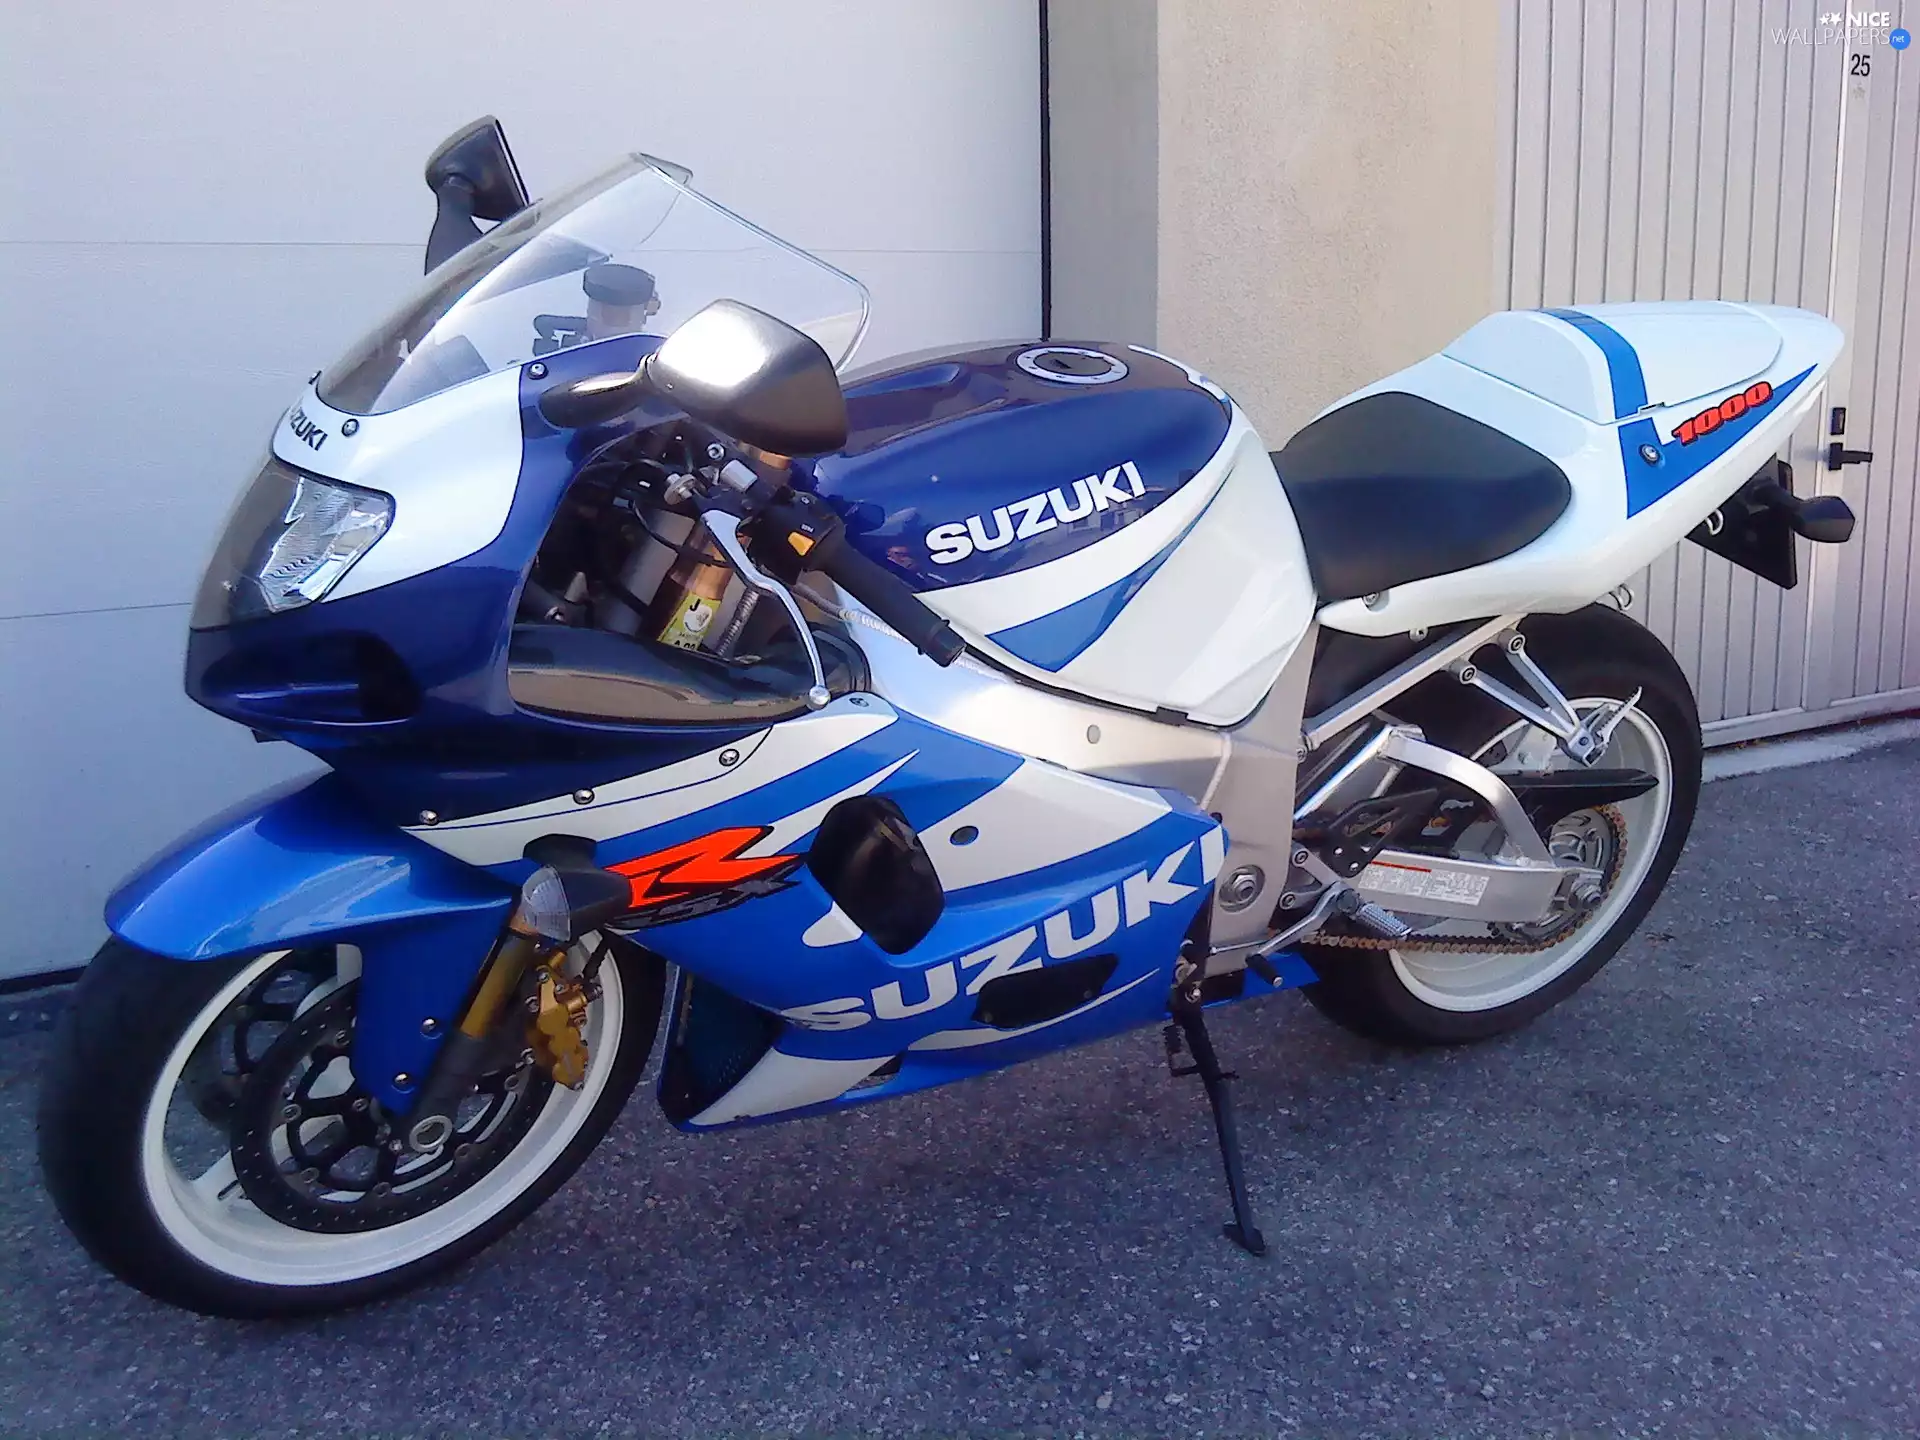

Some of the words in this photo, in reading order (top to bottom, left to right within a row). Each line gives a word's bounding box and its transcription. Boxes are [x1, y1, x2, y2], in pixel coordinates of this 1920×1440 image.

[1850, 53, 1871, 77] 25
[1671, 381, 1773, 446] 1000
[925, 459, 1147, 566] SUZUKI
[779, 826, 1225, 1031] SUZUKI
